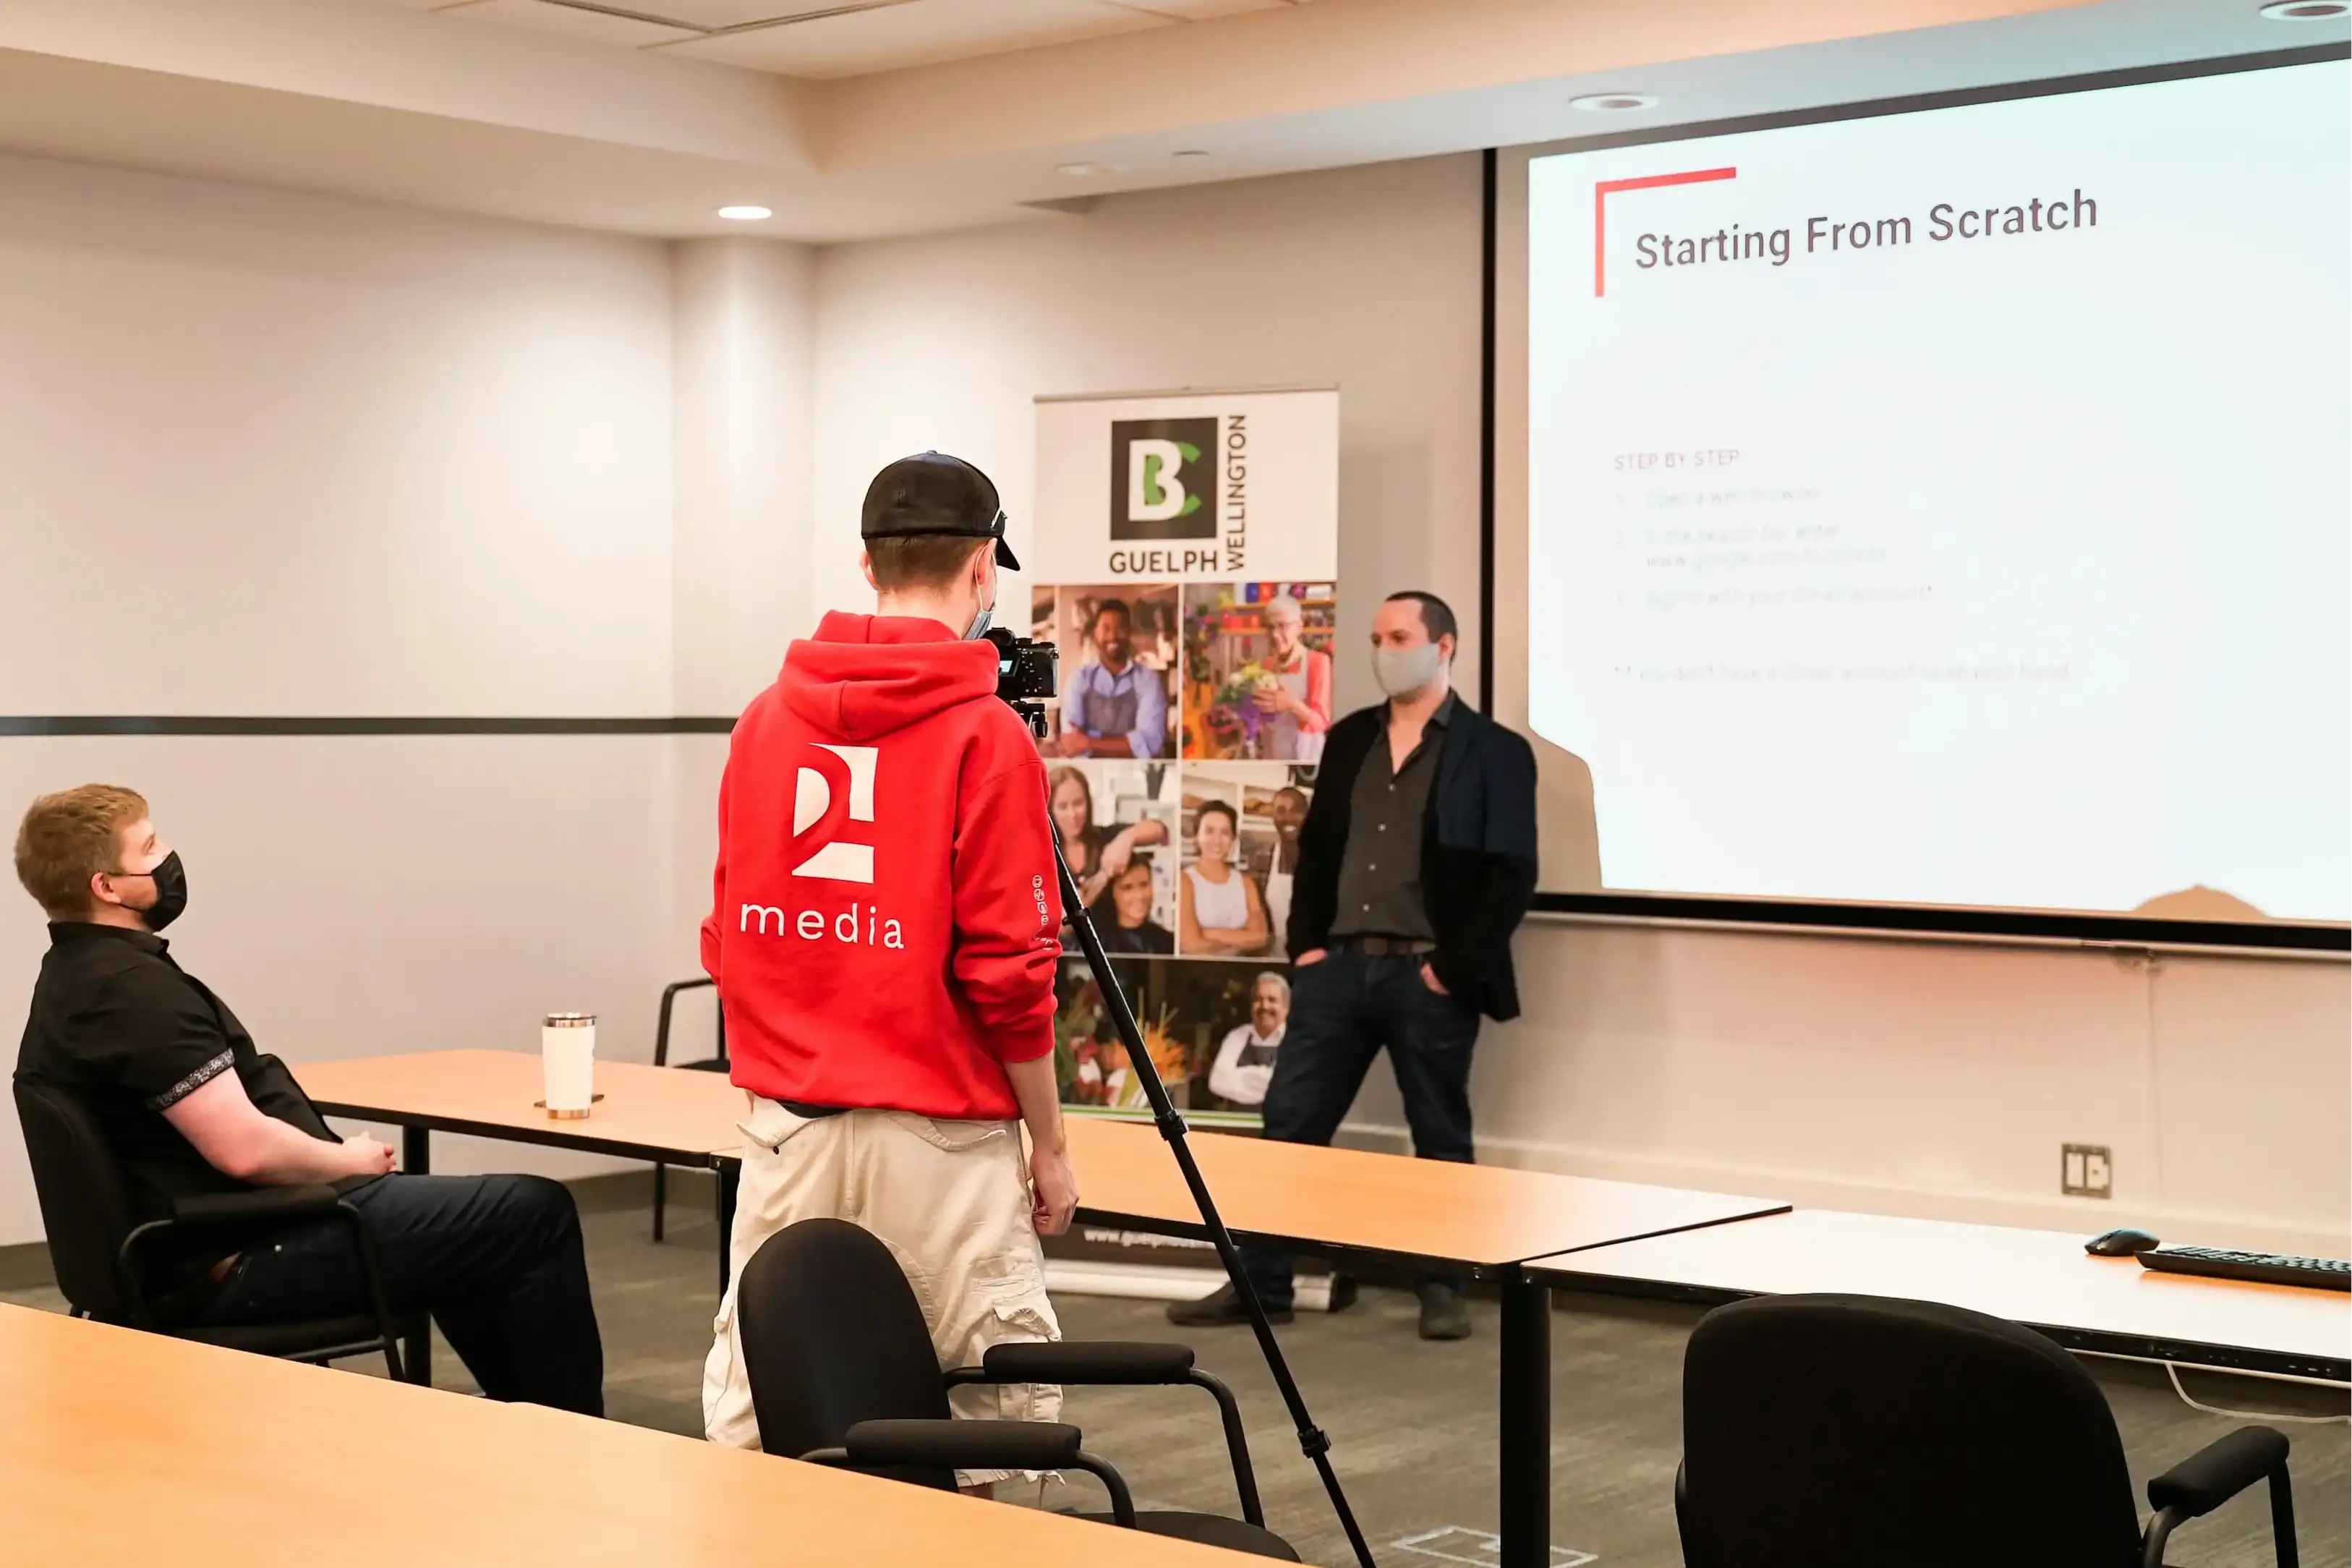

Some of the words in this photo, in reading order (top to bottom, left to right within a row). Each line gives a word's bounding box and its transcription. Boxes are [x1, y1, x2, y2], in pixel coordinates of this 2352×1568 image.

[1635, 224, 1790, 268] Starting
[1807, 216, 1912, 252] From
[1929, 189, 2097, 242] Scratch
[1614, 454, 1658, 470] STEP
[1665, 452, 1684, 468] BY
[1694, 449, 1739, 466] STEP
[1227, 415, 1246, 571] WELLINGTON
[1109, 550, 1217, 574] GUELPH
[740, 903, 905, 950] media
